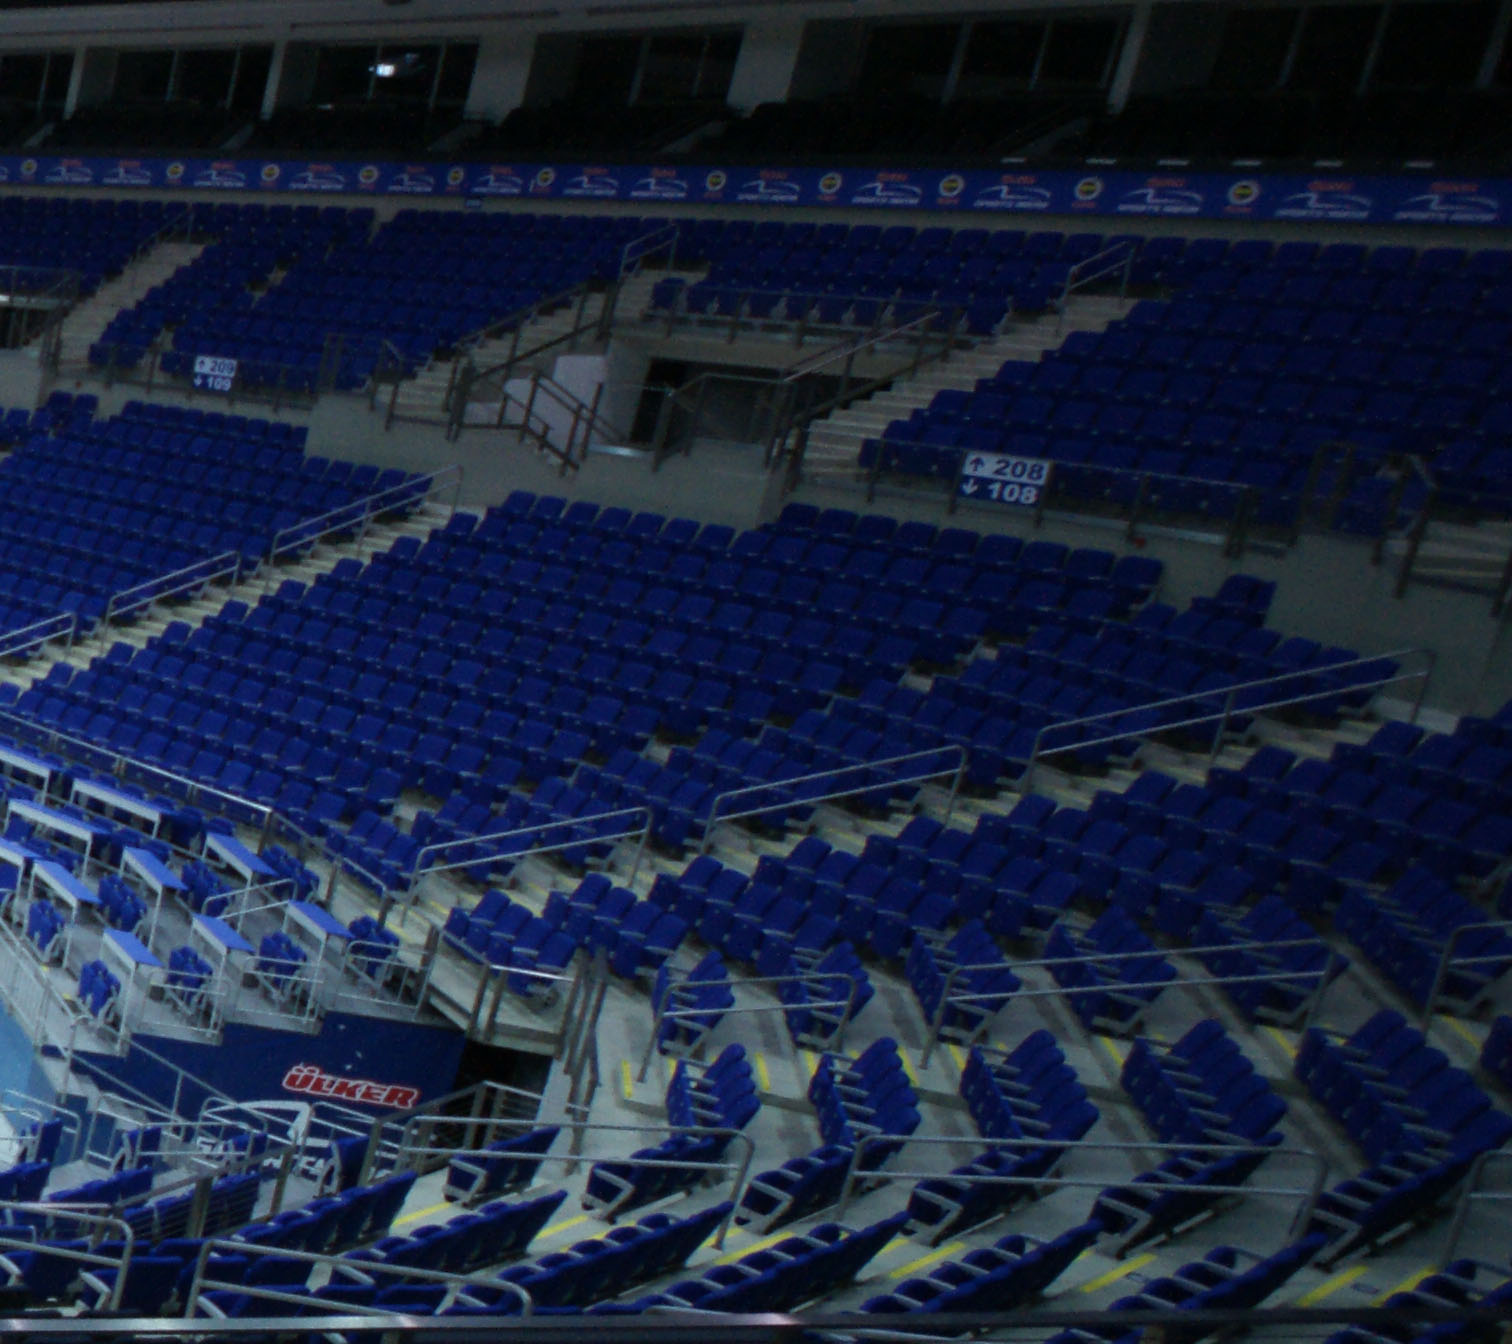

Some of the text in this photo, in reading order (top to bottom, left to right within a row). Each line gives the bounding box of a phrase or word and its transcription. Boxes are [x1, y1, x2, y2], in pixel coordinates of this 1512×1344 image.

[210, 360, 235, 374] 209
[207, 376, 231, 391] 109
[995, 458, 1046, 482] 208
[987, 482, 1039, 505] 108
[282, 1065, 422, 1109] ÜLKER
